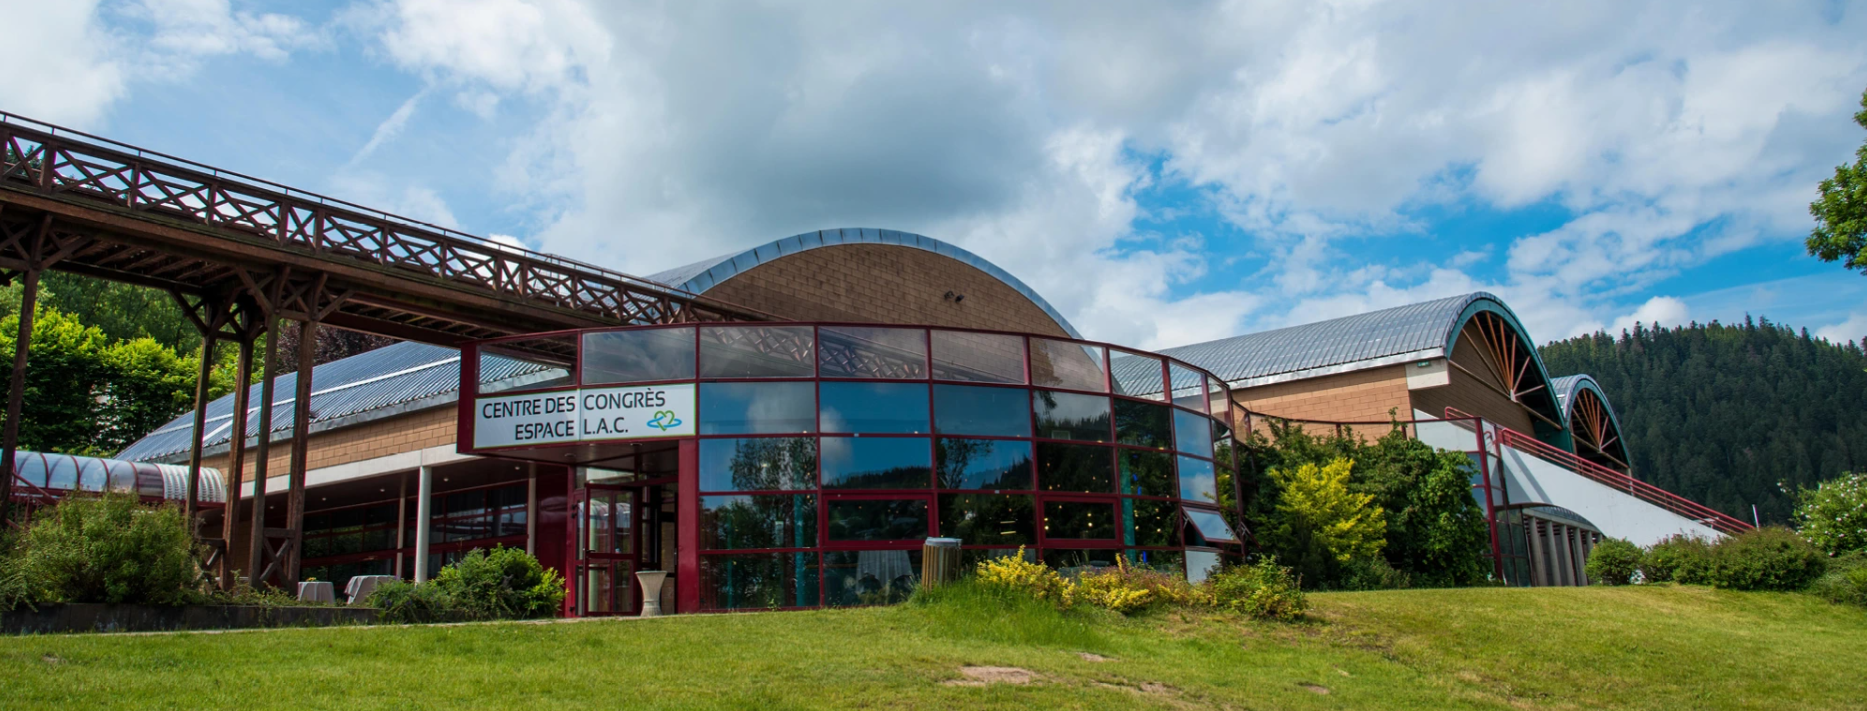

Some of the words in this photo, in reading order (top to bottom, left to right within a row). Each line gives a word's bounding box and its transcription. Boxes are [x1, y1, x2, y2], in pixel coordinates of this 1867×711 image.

[483, 399, 541, 418] CENTRE
[545, 396, 575, 414] DES
[584, 388, 665, 410] CONGRÈS
[515, 420, 574, 440] ESPACE
[584, 417, 628, 435] L.A.C.
